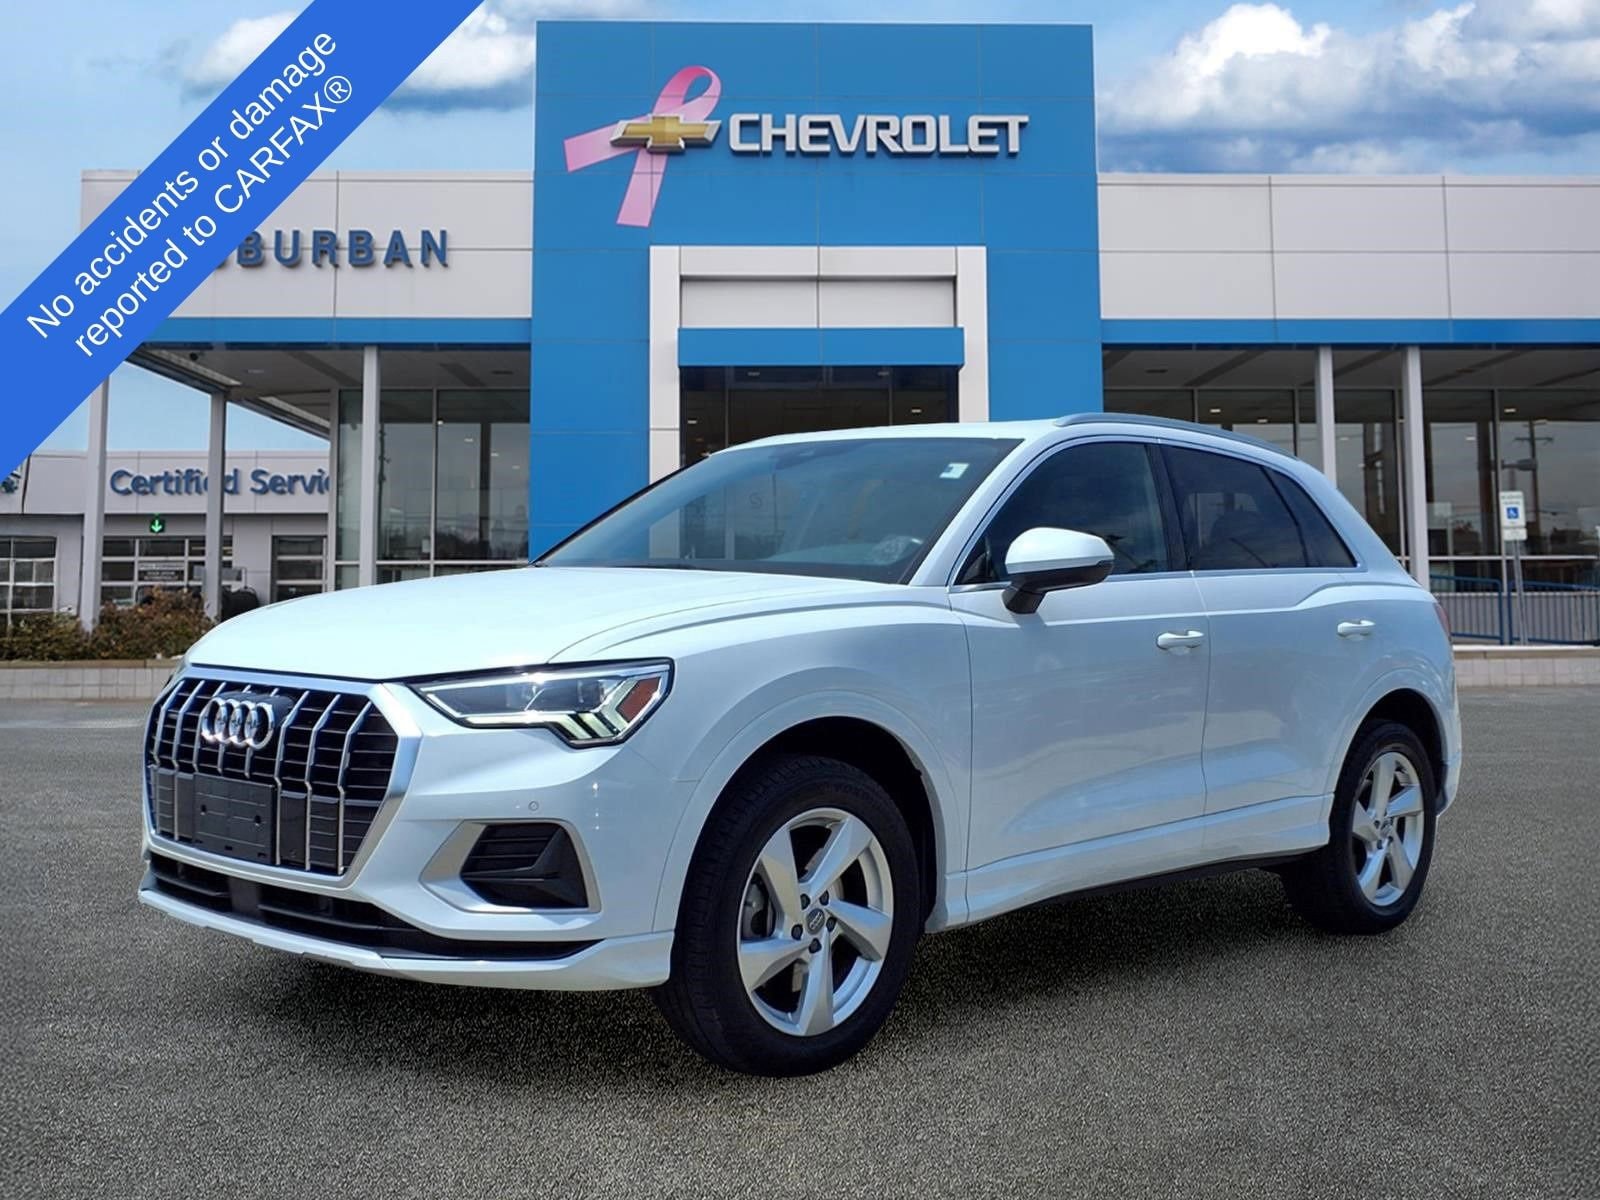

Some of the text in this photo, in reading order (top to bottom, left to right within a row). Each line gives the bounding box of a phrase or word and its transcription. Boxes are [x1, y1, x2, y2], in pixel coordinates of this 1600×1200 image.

[728, 113, 1029, 155] CHEVROLET
[217, 229, 448, 268] BURBAN
[110, 468, 239, 495] Certifid
